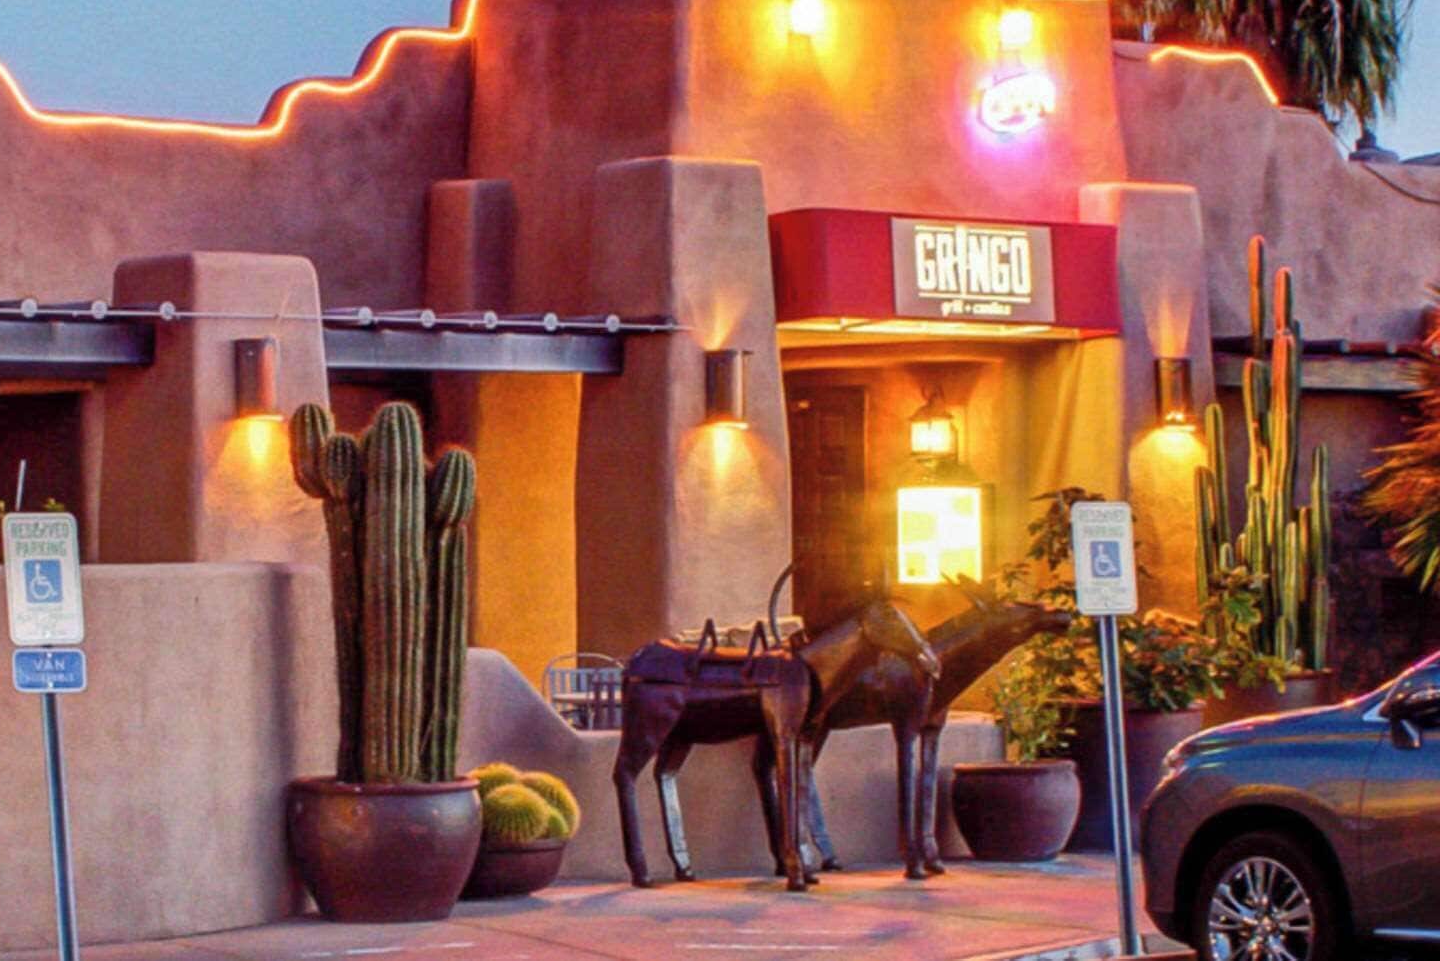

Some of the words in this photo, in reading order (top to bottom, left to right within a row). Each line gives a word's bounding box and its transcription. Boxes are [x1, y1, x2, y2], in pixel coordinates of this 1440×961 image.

[914, 226, 1031, 295] GRINGO
[15, 541, 67, 557] PARKING
[33, 659, 65, 671] VAN
